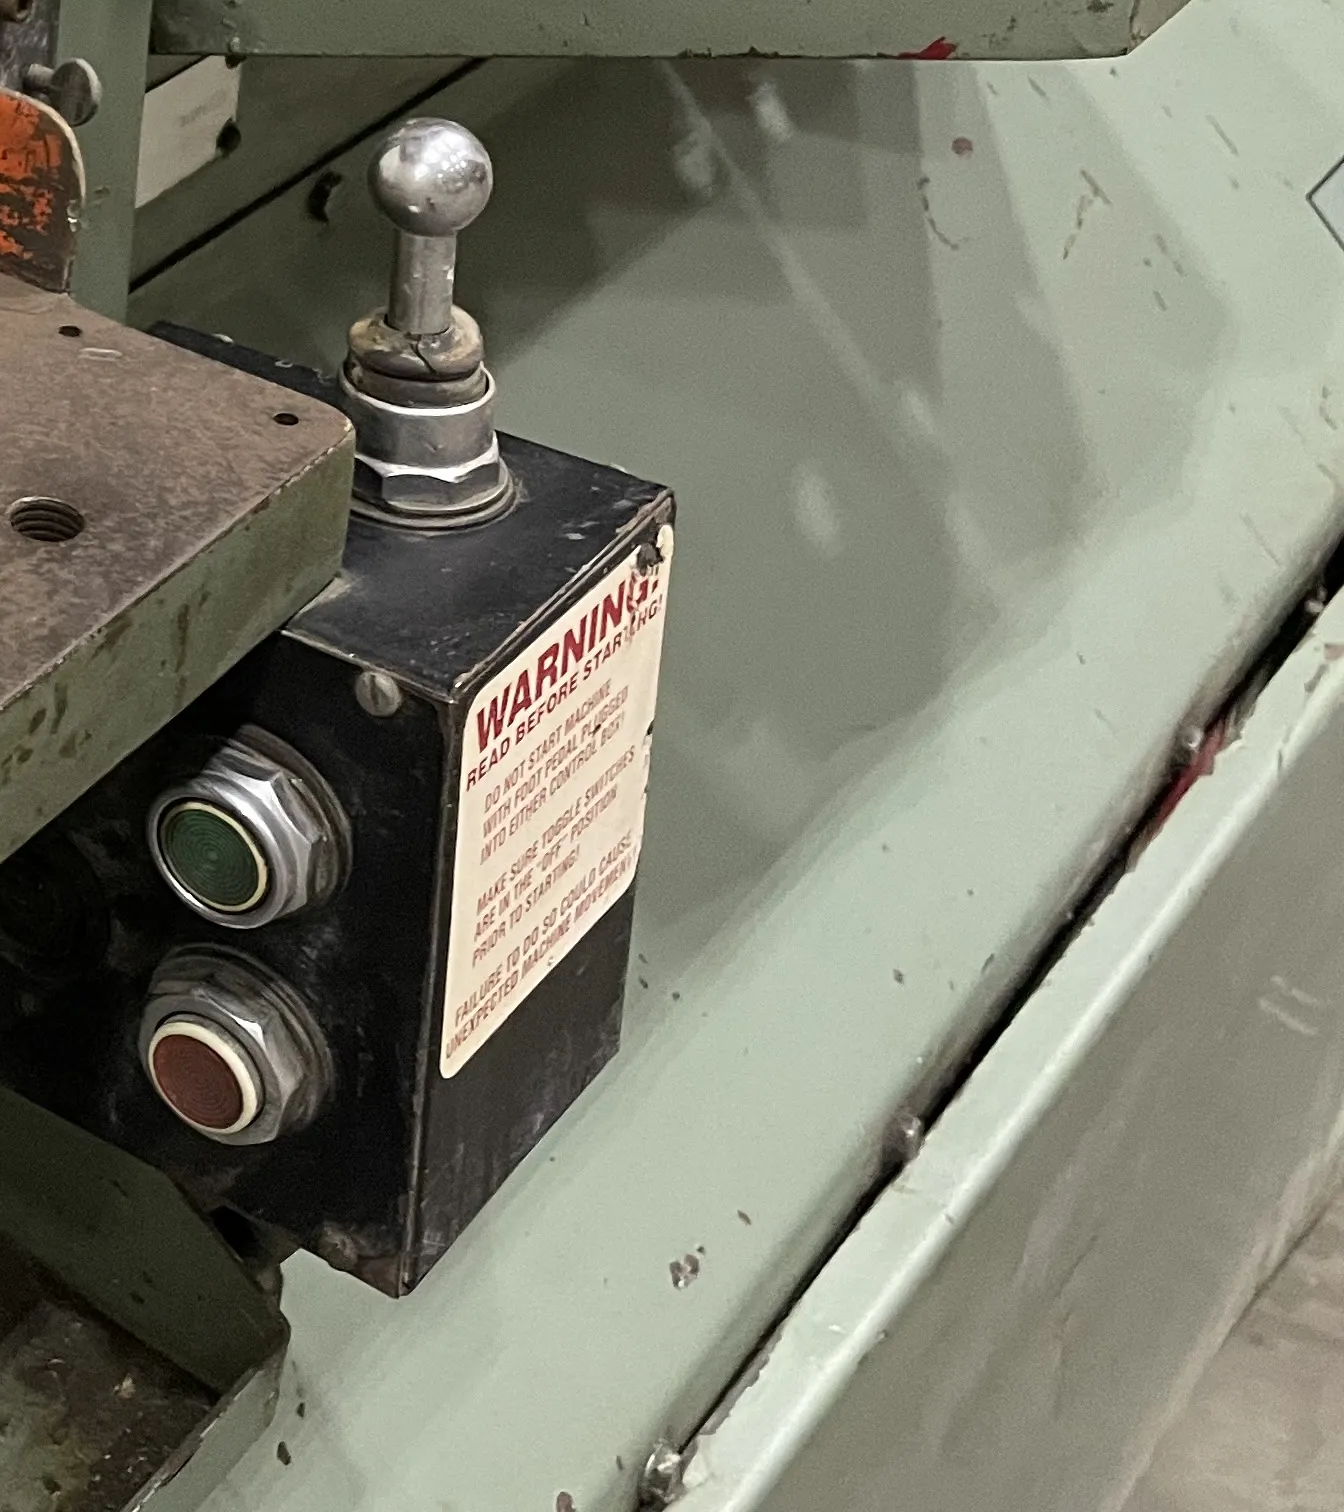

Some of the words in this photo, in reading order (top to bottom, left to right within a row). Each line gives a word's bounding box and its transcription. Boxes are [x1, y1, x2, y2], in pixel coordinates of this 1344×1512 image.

[466, 739, 510, 792] READ
[515, 671, 579, 746] BEFORE
[484, 785, 501, 814] DO
[503, 759, 526, 796] NOT
[528, 724, 563, 771] START
[480, 827, 507, 866] INTO
[509, 787, 547, 837] EITHER
[549, 739, 598, 797] CONTROL
[482, 797, 512, 839] WITH
[514, 766, 544, 809] FOOT
[545, 734, 578, 779] PEDAL
[474, 905, 496, 943] ARE
[514, 867, 535, 901] THE
[510, 839, 540, 882] SURE
[455, 963, 503, 1028] FAILURE
[506, 945, 521, 973] TO
[523, 925, 540, 956] DO
[472, 921, 507, 969] PRIOR
[509, 903, 523, 930] TO
[446, 968, 519, 1060] UNEXPECTED
